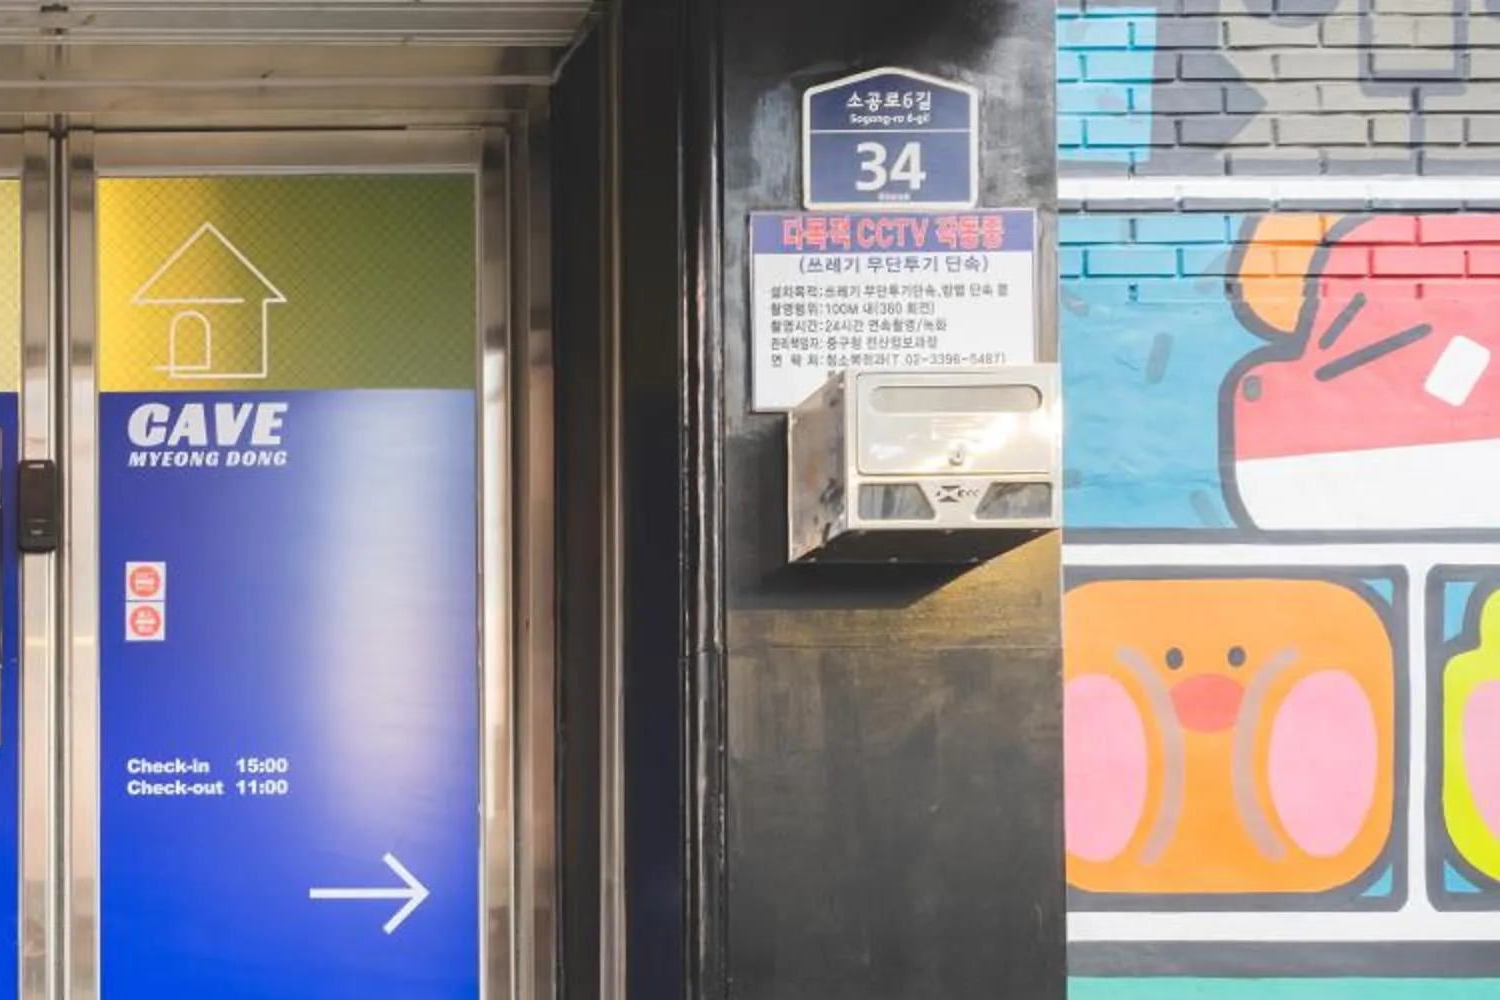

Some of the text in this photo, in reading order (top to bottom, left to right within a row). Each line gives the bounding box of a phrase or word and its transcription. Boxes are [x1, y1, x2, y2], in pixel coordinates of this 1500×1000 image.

[846, 91, 931, 112] 소공로6길
[855, 141, 927, 191] 34
[857, 218, 928, 248] CCTV
[799, 255, 989, 274] (쓰레기 무단투기 단속)
[127, 401, 290, 447] CAVE
[128, 449, 288, 467] MYEONG DONG
[126, 757, 290, 774] Check-in 15:00
[126, 778, 289, 796] Check-out 11:00
